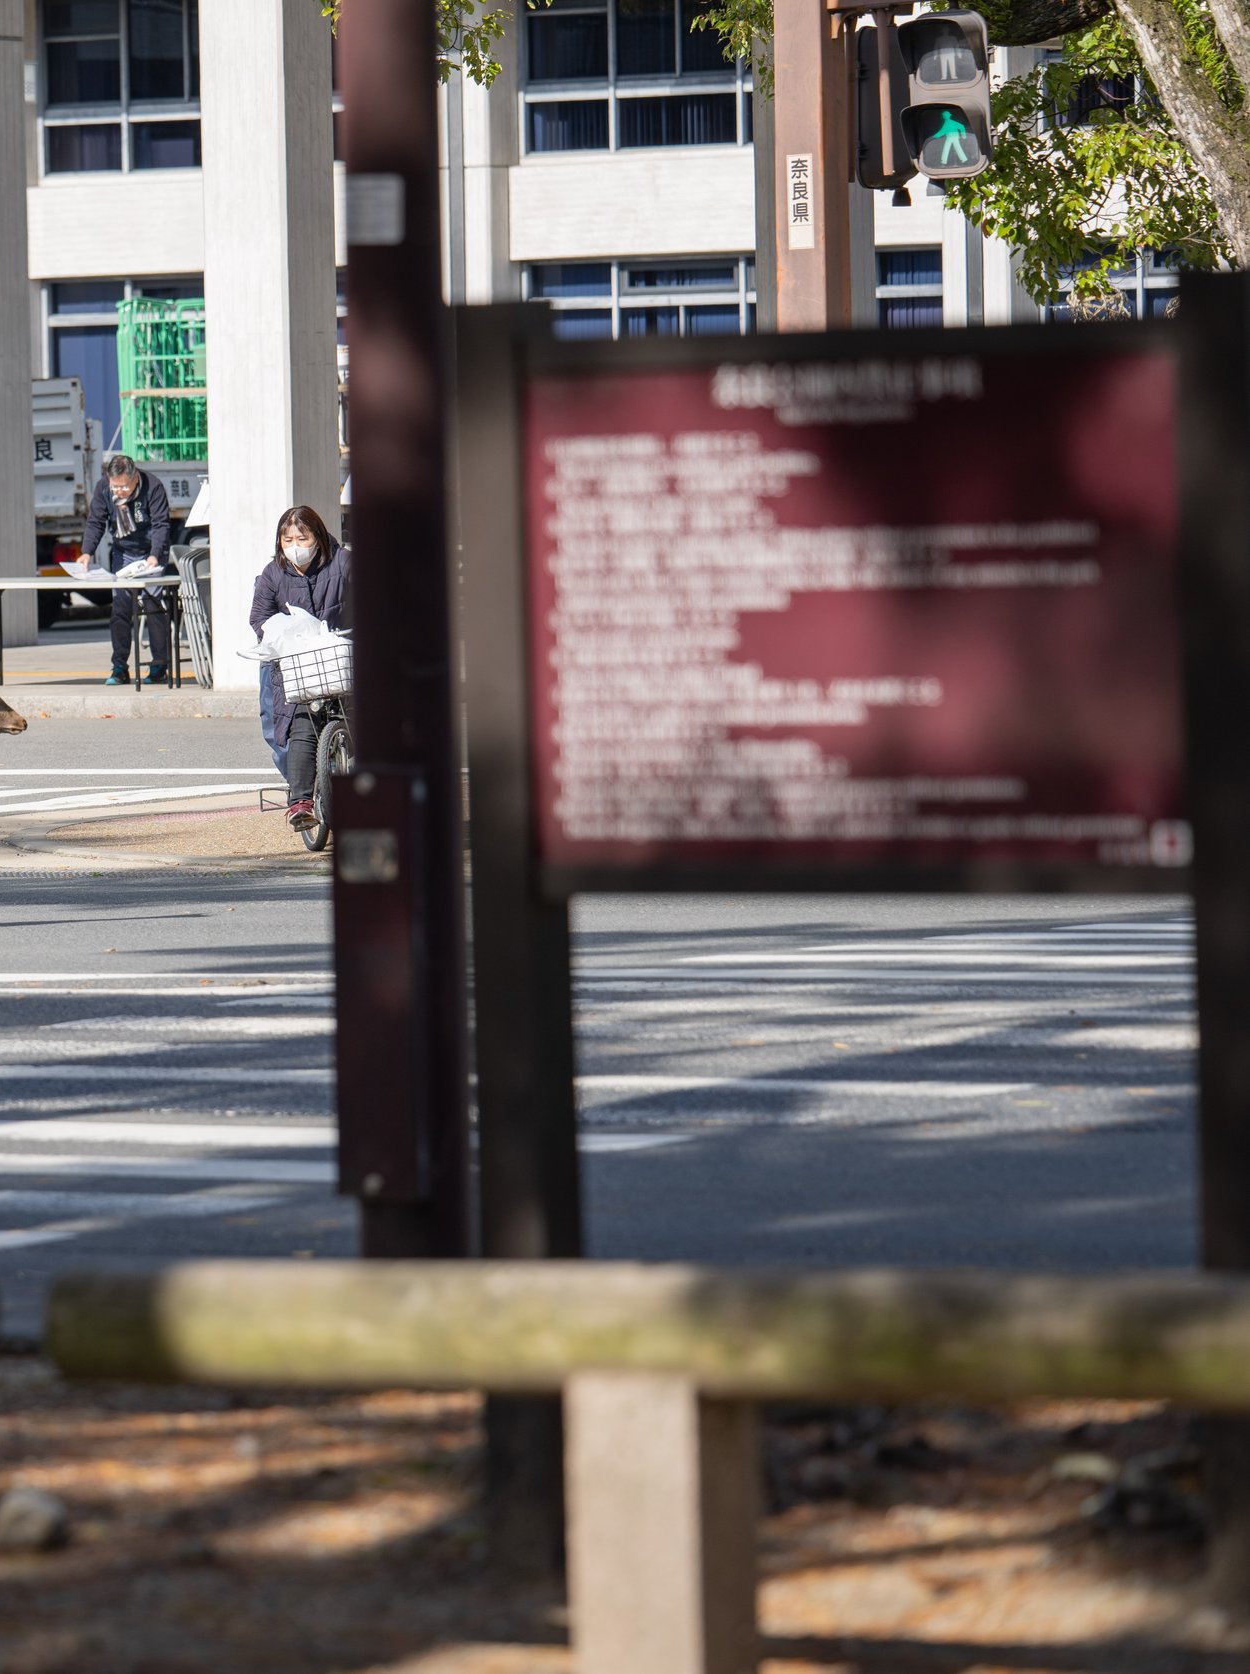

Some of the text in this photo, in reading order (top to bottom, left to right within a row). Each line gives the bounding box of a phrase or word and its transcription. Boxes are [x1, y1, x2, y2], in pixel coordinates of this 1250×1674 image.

[791, 158, 808, 223] 奈良県
[34, 439, 53, 461] 良
[171, 480, 190, 498] 奈良
